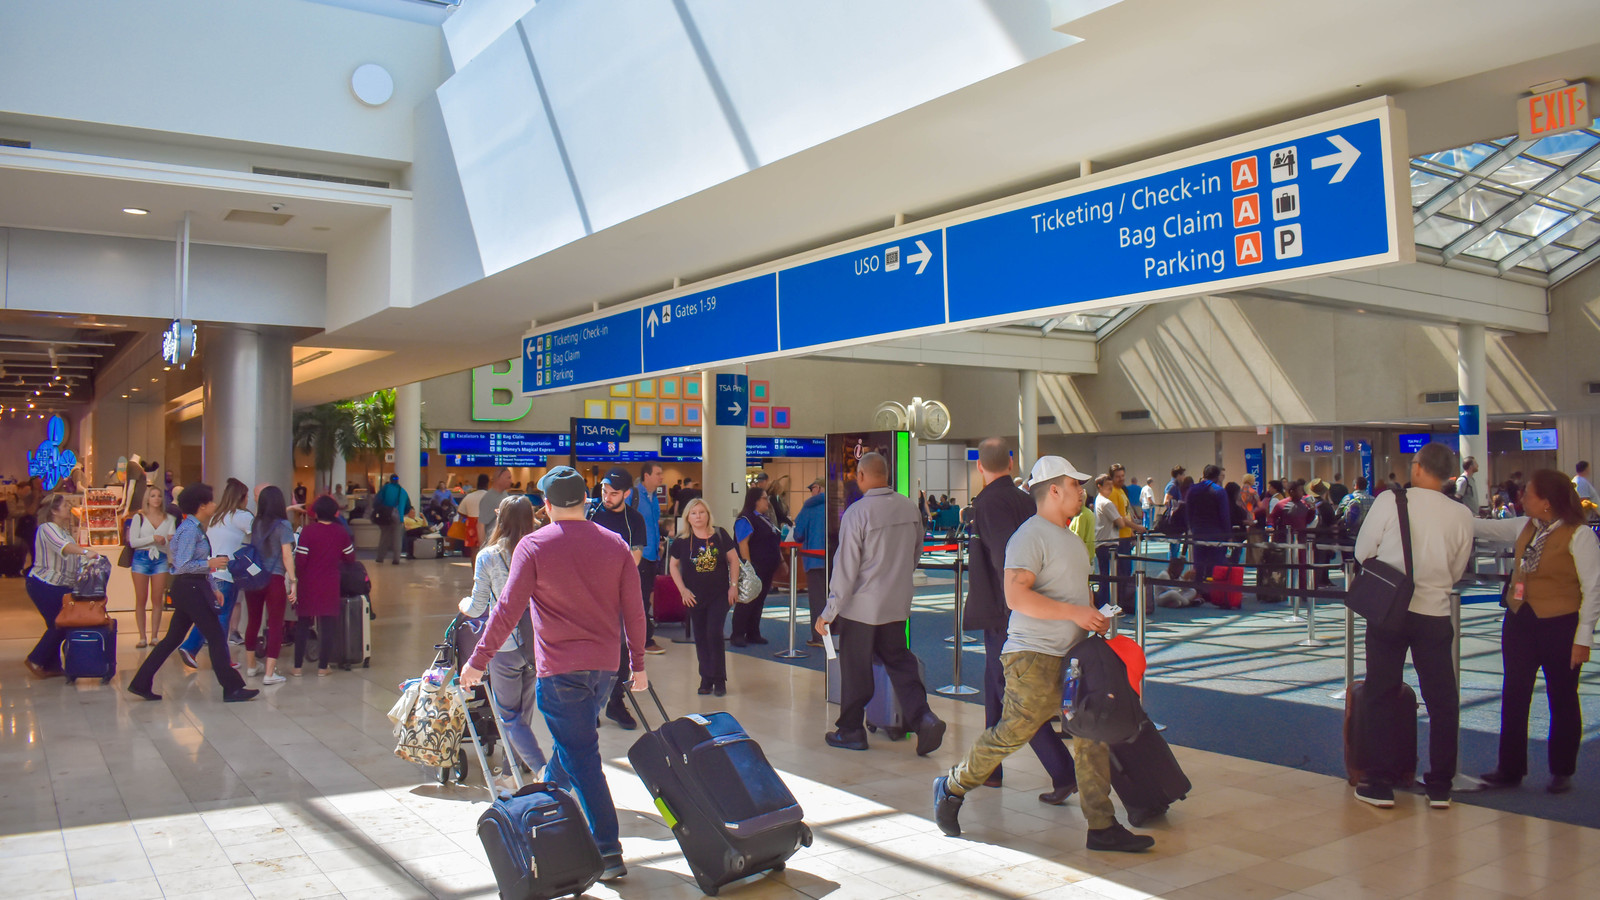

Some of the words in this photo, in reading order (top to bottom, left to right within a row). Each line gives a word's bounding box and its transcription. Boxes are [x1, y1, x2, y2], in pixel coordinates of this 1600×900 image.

[1529, 87, 1577, 134] EXIT
[1031, 201, 1113, 234] Ticketing
[1119, 193, 1126, 215] /
[1131, 173, 1221, 210] Check-in
[1236, 164, 1254, 186] A
[1119, 225, 1156, 248] Bag
[1163, 211, 1223, 238] Claim
[1238, 200, 1256, 223] A
[855, 255, 880, 275] USO
[1144, 248, 1225, 278] Parking
[1240, 239, 1258, 261] A
[675, 303, 697, 318] Gates
[700, 296, 716, 312] 1-59
[553, 332, 578, 346] Ticketing
[583, 324, 608, 340] Check-in
[553, 353, 563, 365] Bag
[565, 349, 580, 361] Claim
[553, 368, 574, 381] Parking
[581, 425, 599, 435] TSA
[600, 426, 615, 435] Pre
